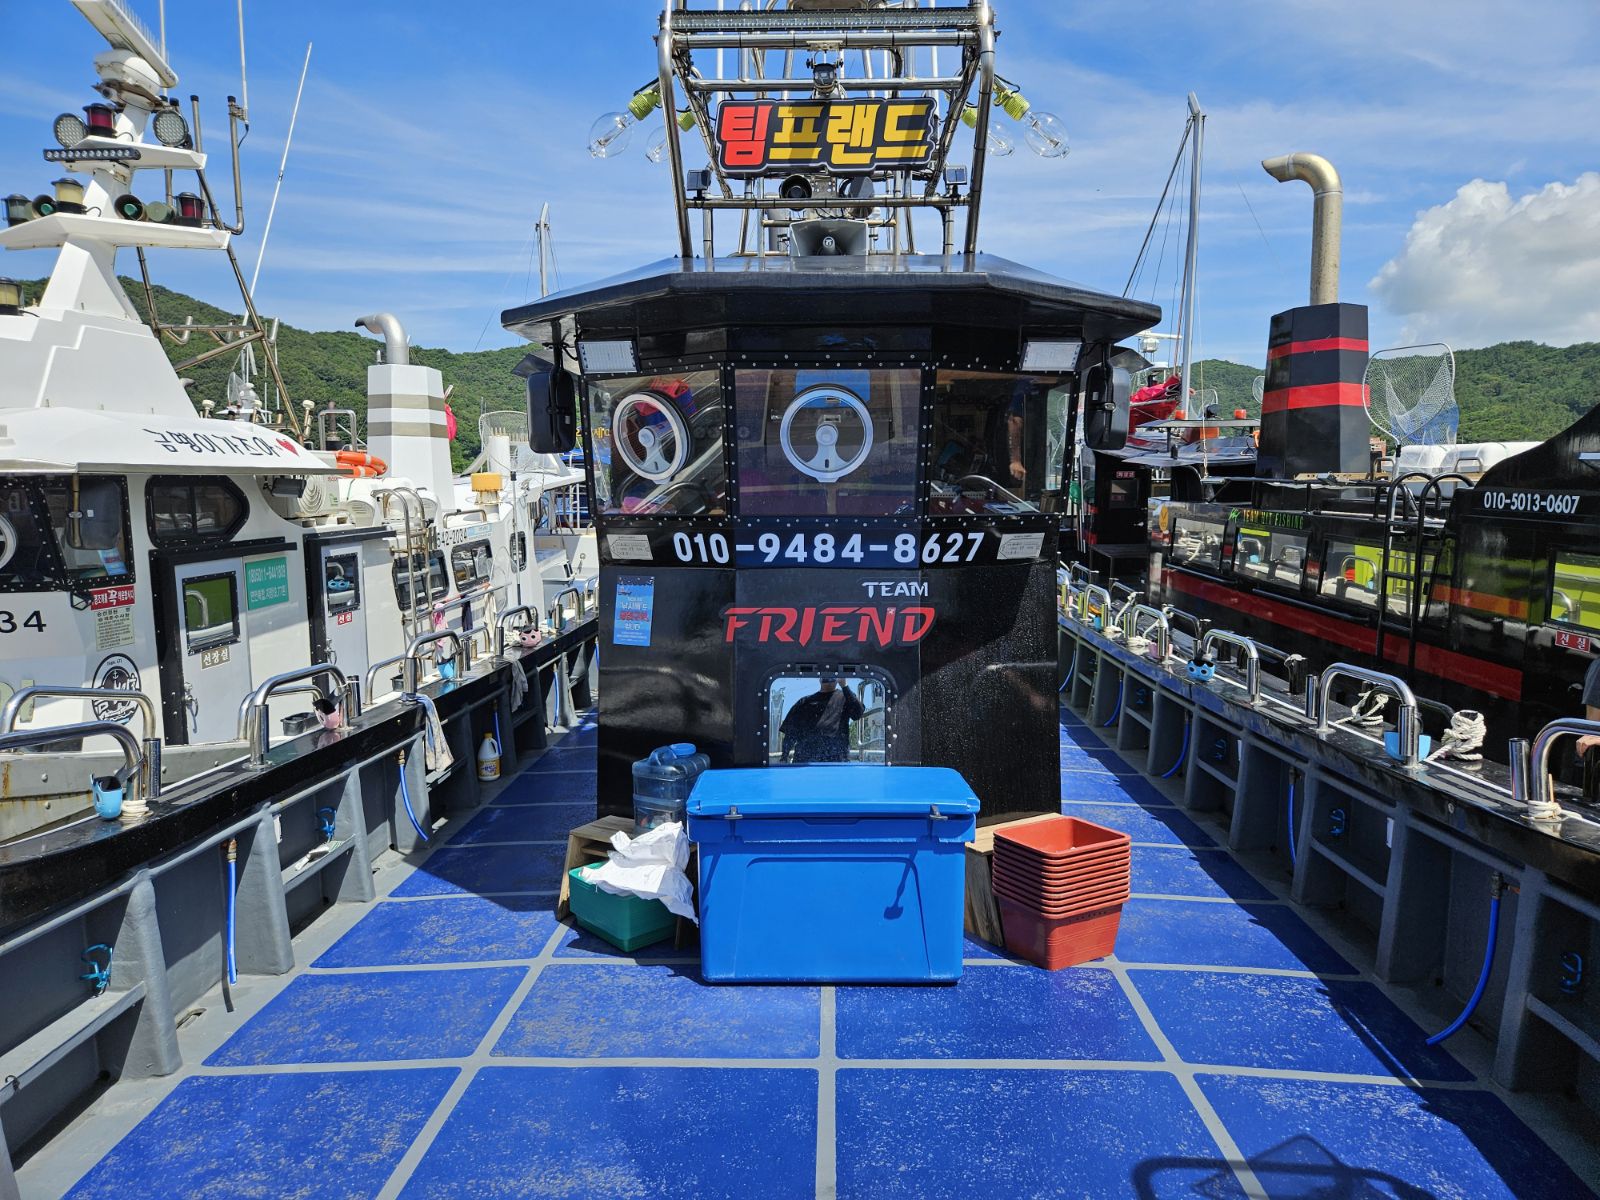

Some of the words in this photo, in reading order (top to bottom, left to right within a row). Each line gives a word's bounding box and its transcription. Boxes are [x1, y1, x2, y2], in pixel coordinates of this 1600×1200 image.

[720, 104, 930, 166] 팀프랜드
[1483, 491, 1581, 514] 010-5013-0607
[673, 531, 985, 563] 010-9484-8627
[862, 581, 928, 598] TEAM
[723, 607, 936, 647] FRIEND
[203, 648, 229, 666] 선장실
